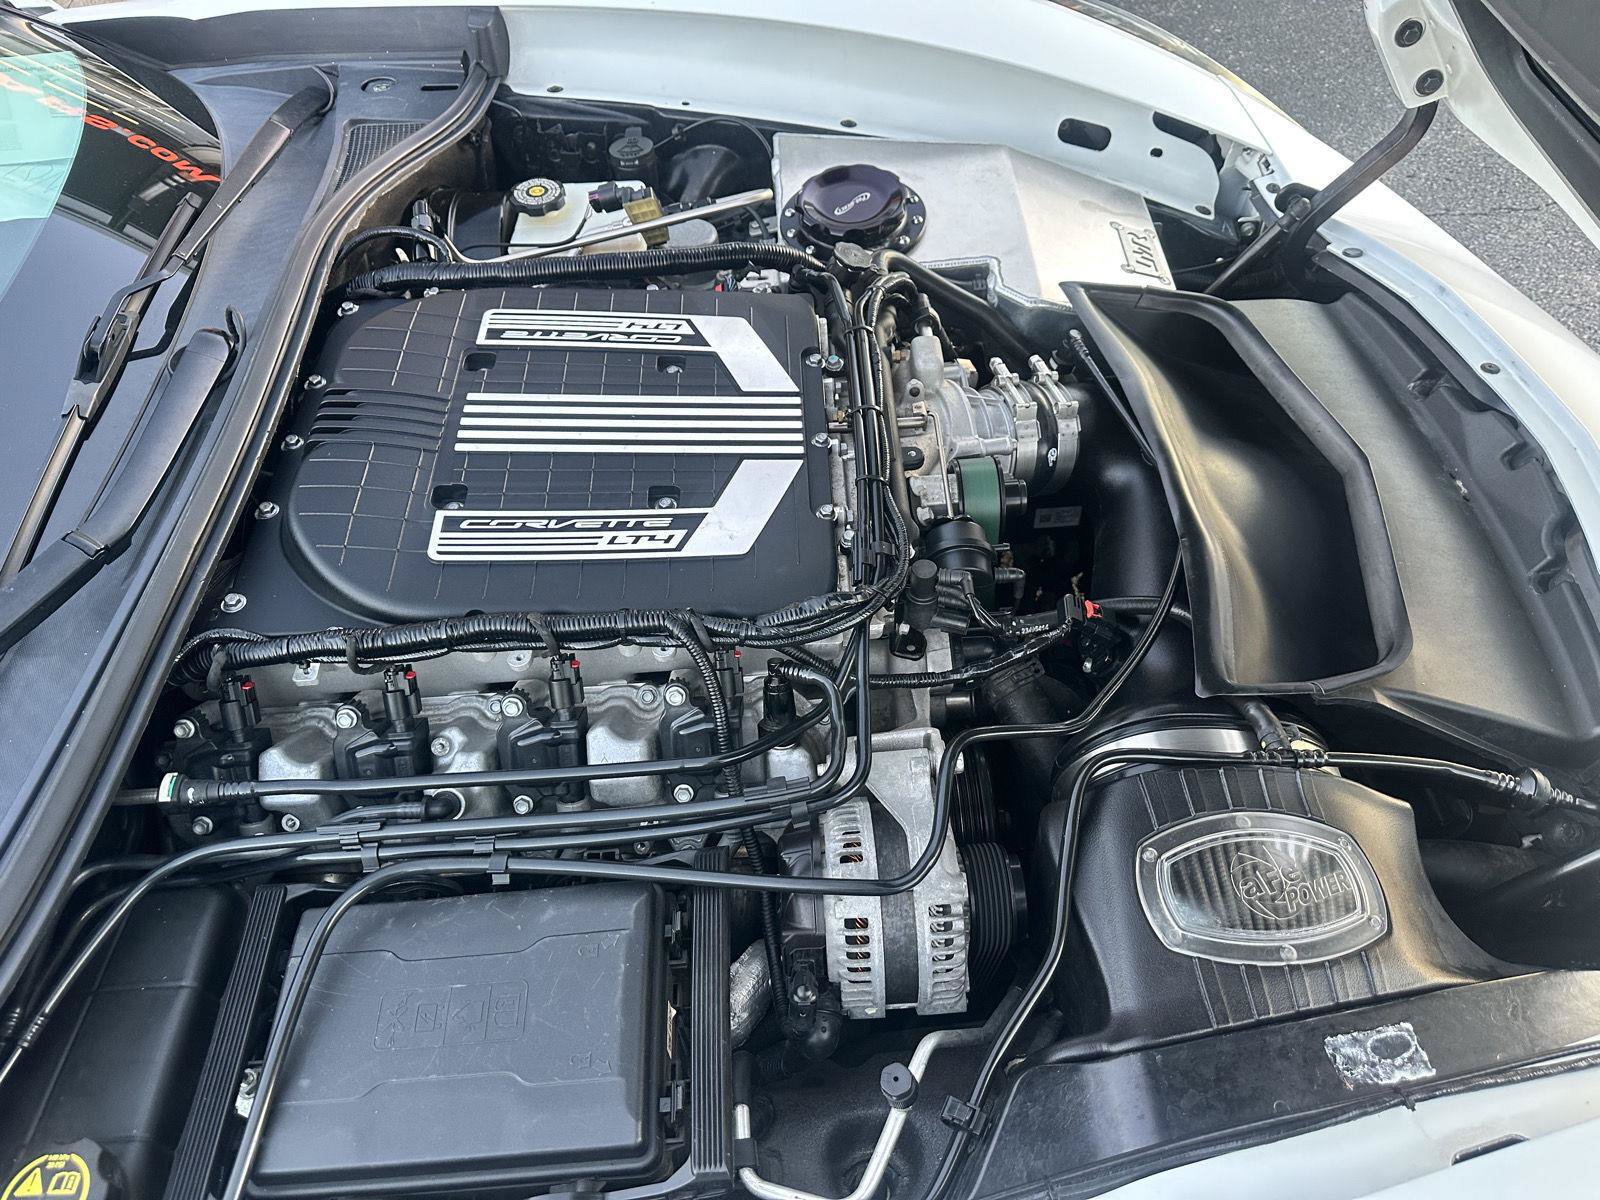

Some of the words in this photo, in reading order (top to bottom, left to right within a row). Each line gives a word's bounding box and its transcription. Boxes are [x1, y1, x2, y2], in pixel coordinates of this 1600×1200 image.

[500, 330, 683, 344] CORVETTE
[459, 517, 674, 529] CORVETTE
[606, 534, 673, 545] LT4
[1284, 871, 1353, 913] POWER
